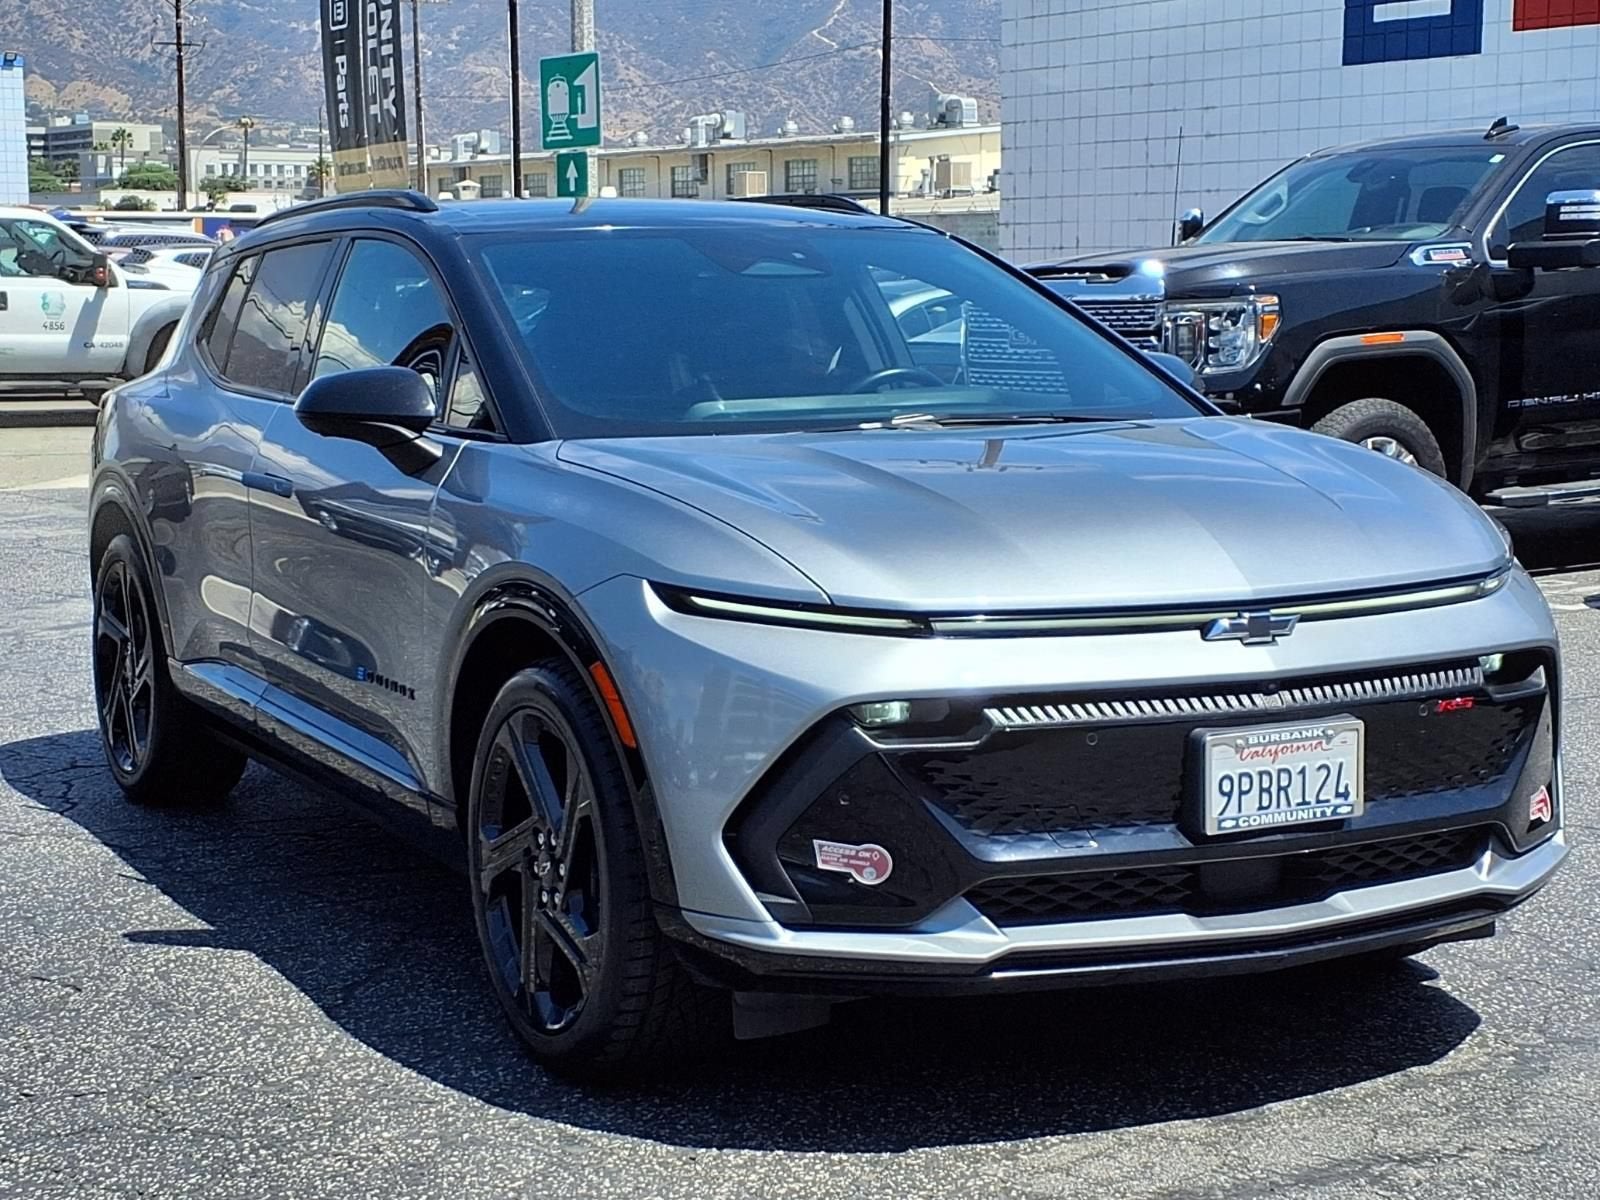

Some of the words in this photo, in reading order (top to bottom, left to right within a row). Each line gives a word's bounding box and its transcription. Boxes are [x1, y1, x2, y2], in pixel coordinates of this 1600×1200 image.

[367, 0, 381, 123] OLET
[379, 0, 397, 118] NITY
[335, 54, 349, 129] Parts
[42, 321, 65, 331] 4856
[83, 341, 96, 349] CA
[1507, 394, 1579, 408] DENALI
[1247, 727, 1325, 744] BURBANK
[1238, 740, 1333, 763] California
[1217, 760, 1351, 817] 9PBR124
[1238, 806, 1334, 827] COMMUNITY
